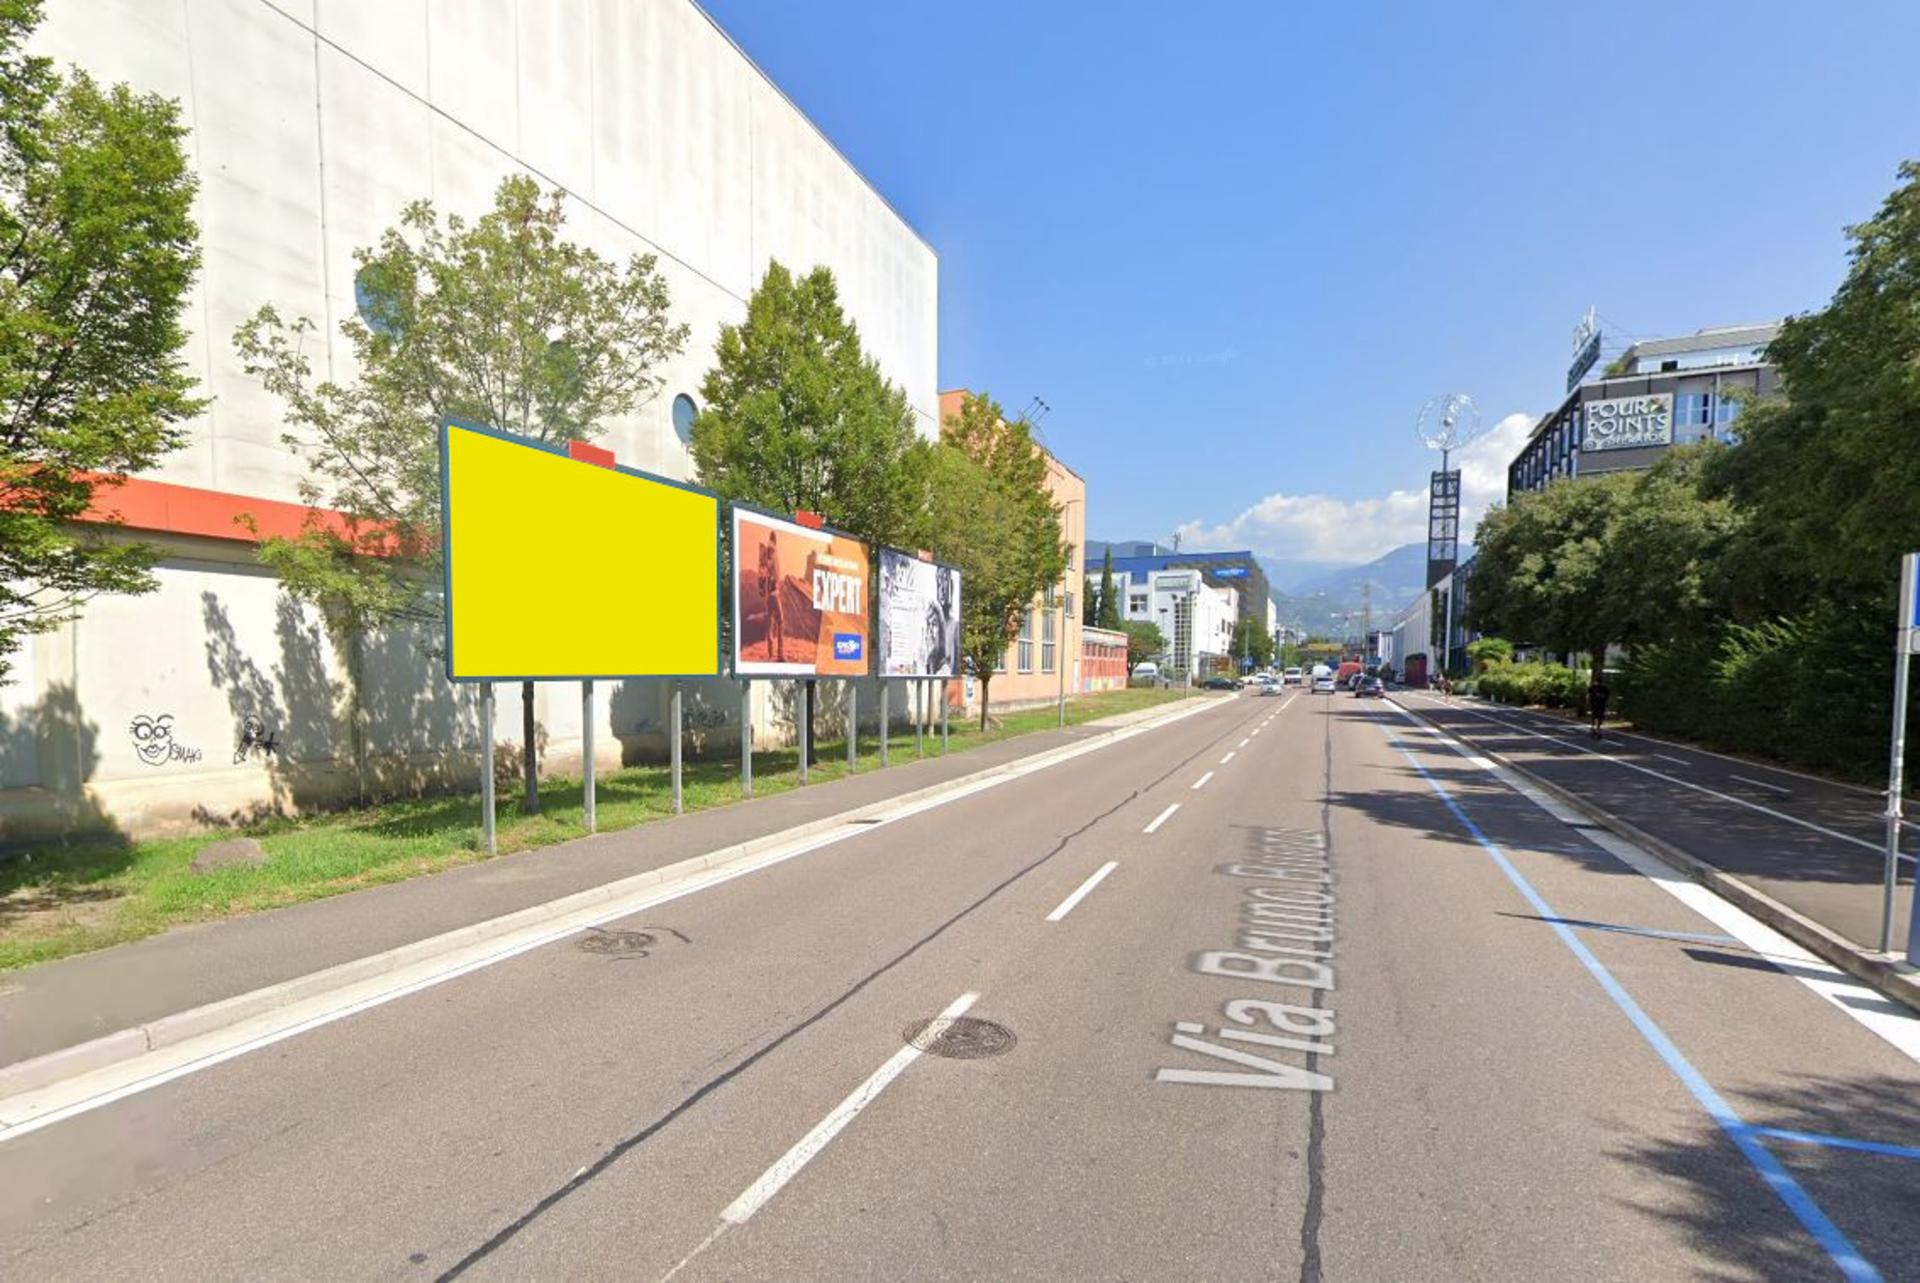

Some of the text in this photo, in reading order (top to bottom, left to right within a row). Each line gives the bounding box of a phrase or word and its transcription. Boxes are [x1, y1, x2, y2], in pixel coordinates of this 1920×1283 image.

[1587, 413, 1665, 435] POINTS
[813, 568, 862, 615] EXPERT
[1199, 886, 1336, 990] Bruno
[1156, 998, 1336, 1091] Via
